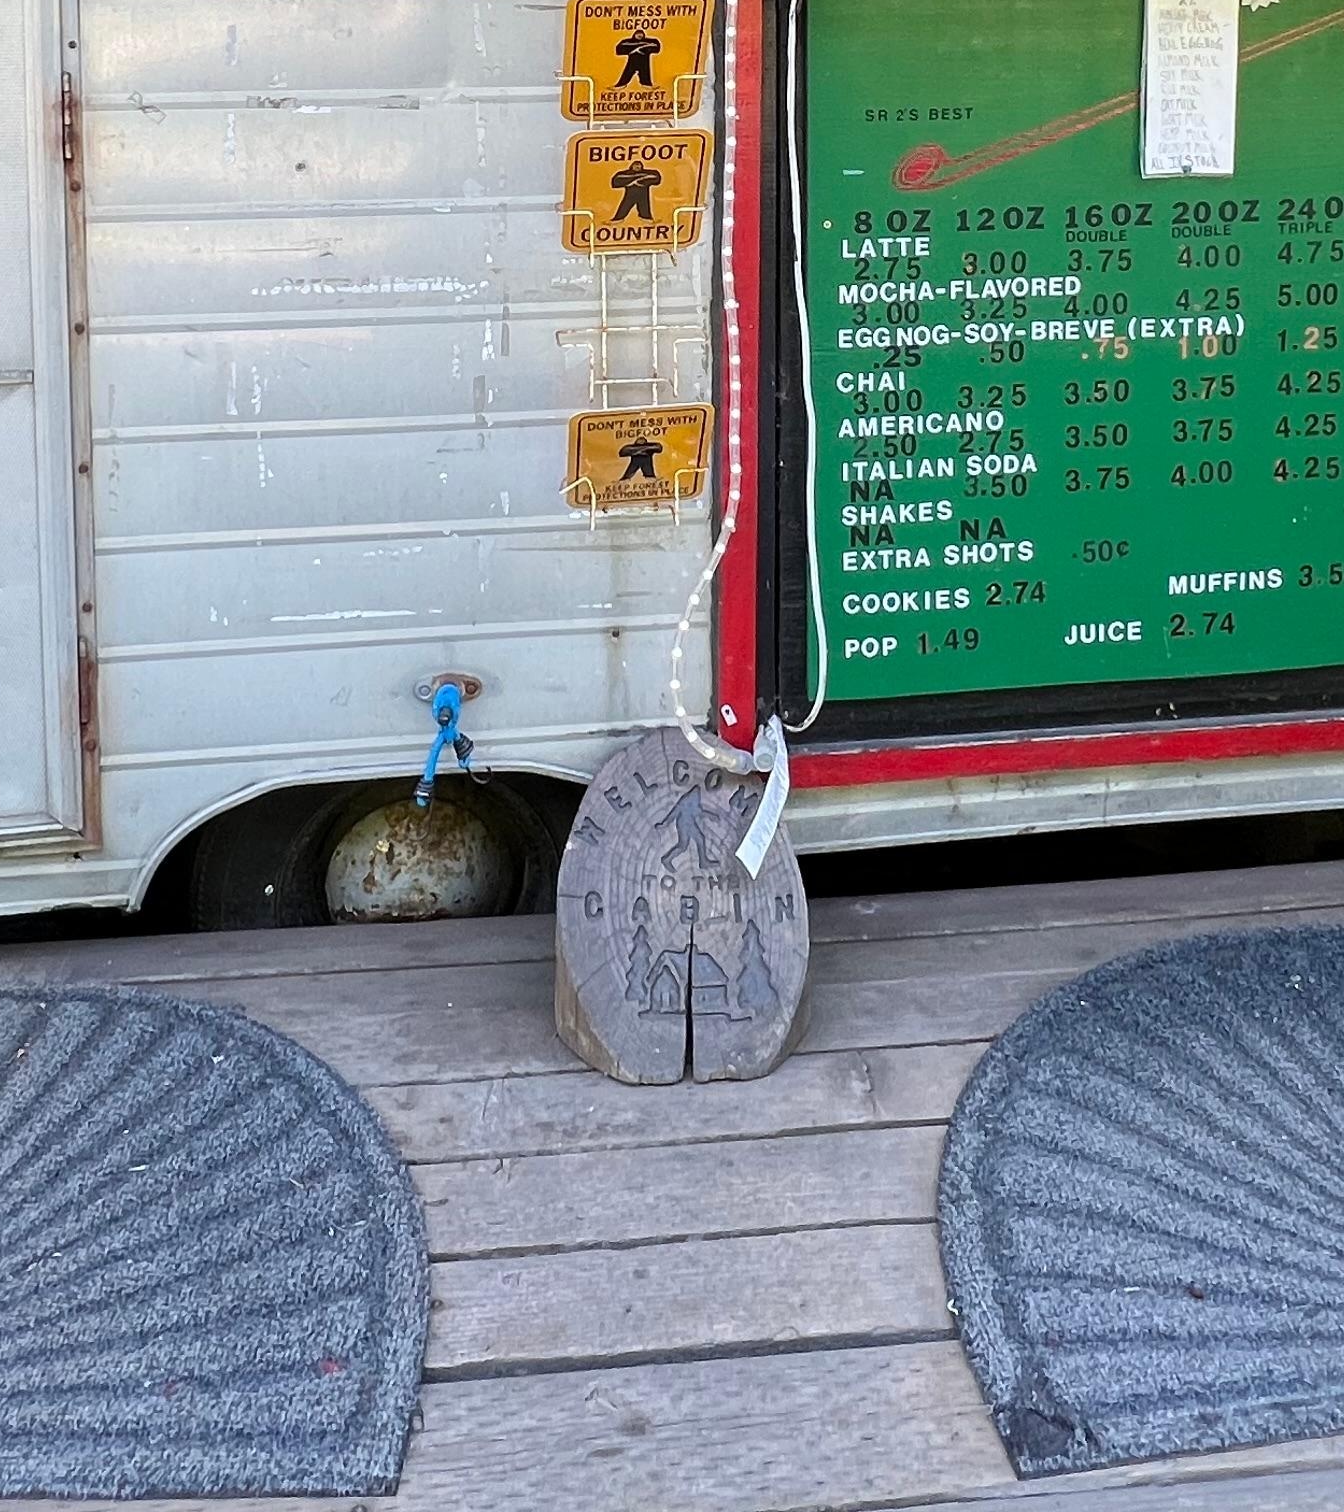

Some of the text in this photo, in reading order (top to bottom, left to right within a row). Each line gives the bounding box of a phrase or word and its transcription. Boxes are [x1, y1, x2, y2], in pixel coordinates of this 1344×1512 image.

[585, 5, 698, 18] DON'T MESS WITH
[613, 18, 667, 30] BIGFOOT
[600, 90, 666, 102] KEEP FOREST
[644, 102, 654, 111] IN
[865, 109, 888, 122] SR
[929, 108, 973, 120] BEST
[589, 144, 688, 162] BIGFOOT
[1065, 230, 1128, 242] DOUBLE
[1171, 224, 1233, 238] DOUBLE
[1278, 221, 1333, 234] TRIPLE
[841, 236, 930, 259] LATTE
[1067, 249, 1133, 273] 3.75
[1277, 241, 1344, 265] 4.75
[838, 276, 1082, 304] MOCHA-FLAVORED
[1063, 283, 1339, 317] 4.00 5.00
[1128, 313, 1245, 339] (EXTRA)
[980, 341, 1025, 364] .50
[836, 371, 906, 393] CHAI
[1065, 375, 1235, 405] 3.50 3.75
[587, 415, 698, 432] DON'T MESS WITH
[616, 427, 668, 439] BIGFOOT
[838, 410, 1004, 438] AMERICANO
[1065, 414, 1336, 448] 3.50 4.25
[842, 453, 1038, 482] ITALIAN SODA
[1065, 467, 1130, 492] 3.75
[841, 500, 953, 526] SHAKES
[842, 540, 1034, 571] EXTRA SHOTS
[842, 588, 970, 614] COOKIES
[985, 581, 1046, 606] 2.74
[1168, 568, 1283, 595] MUFFINS
[844, 612, 1235, 659] POP 1.49 JUICE 2.74
[583, 891, 796, 924] CABIN
